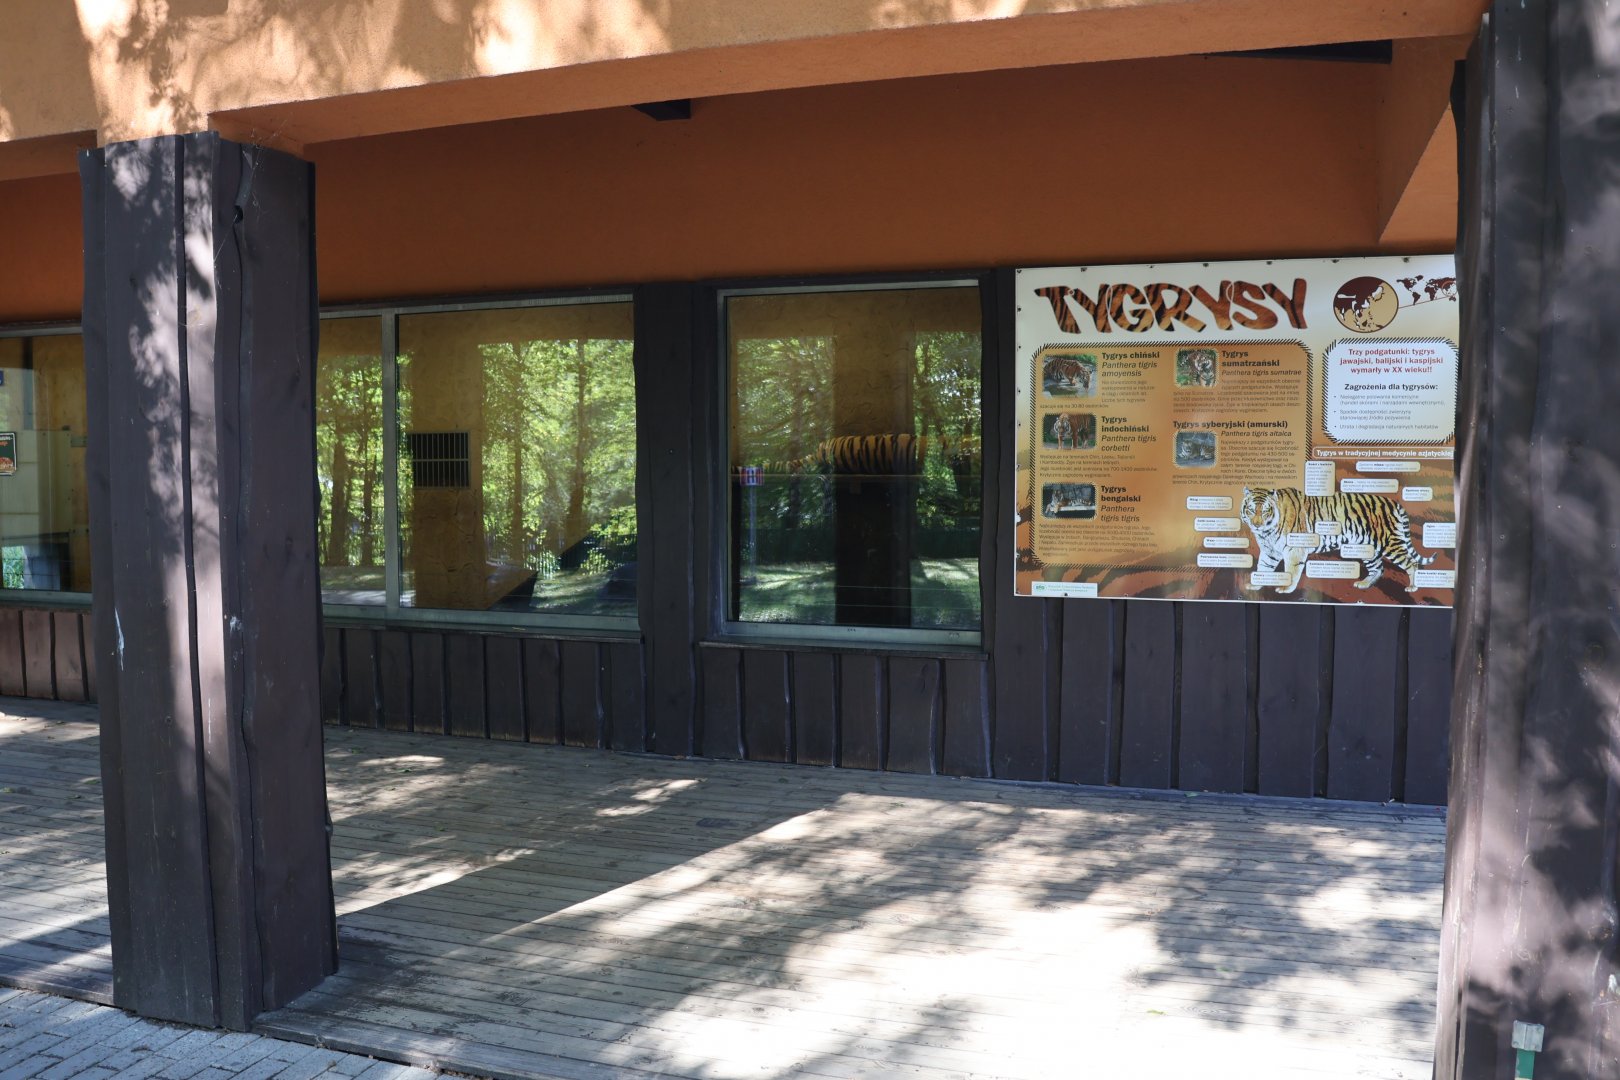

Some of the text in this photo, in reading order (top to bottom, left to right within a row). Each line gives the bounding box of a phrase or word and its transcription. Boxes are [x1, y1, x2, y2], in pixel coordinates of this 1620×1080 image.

[1034, 278, 1308, 334] TYGRYSY
[1101, 351, 1160, 360] Tygrys chiński
[1221, 350, 1249, 358] Tygrys
[1348, 348, 1435, 356] Trzy podgatunki: tygrys
[1101, 361, 1158, 369] Panthera tigris
[1221, 359, 1280, 367] sumatrzański
[1339, 357, 1374, 366] jawajski,
[1375, 357, 1403, 365] balijski
[1409, 357, 1444, 365] kaspijski
[1101, 370, 1142, 378] amoyensis
[1350, 366, 1382, 374] wymarły
[1344, 383, 1387, 391] Zagrożenia
[1402, 382, 1438, 391] tygrysów:
[1101, 416, 1128, 424] Tygrys
[1173, 420, 1288, 429] Tygrys syberyjski (amurski)
[1138, 434, 1157, 443] tigris
[1101, 444, 1130, 452] corbetti
[1100, 485, 1127, 494] Tygrys
[1100, 494, 1141, 502] bengalski
[1121, 514, 1140, 522] tigris
